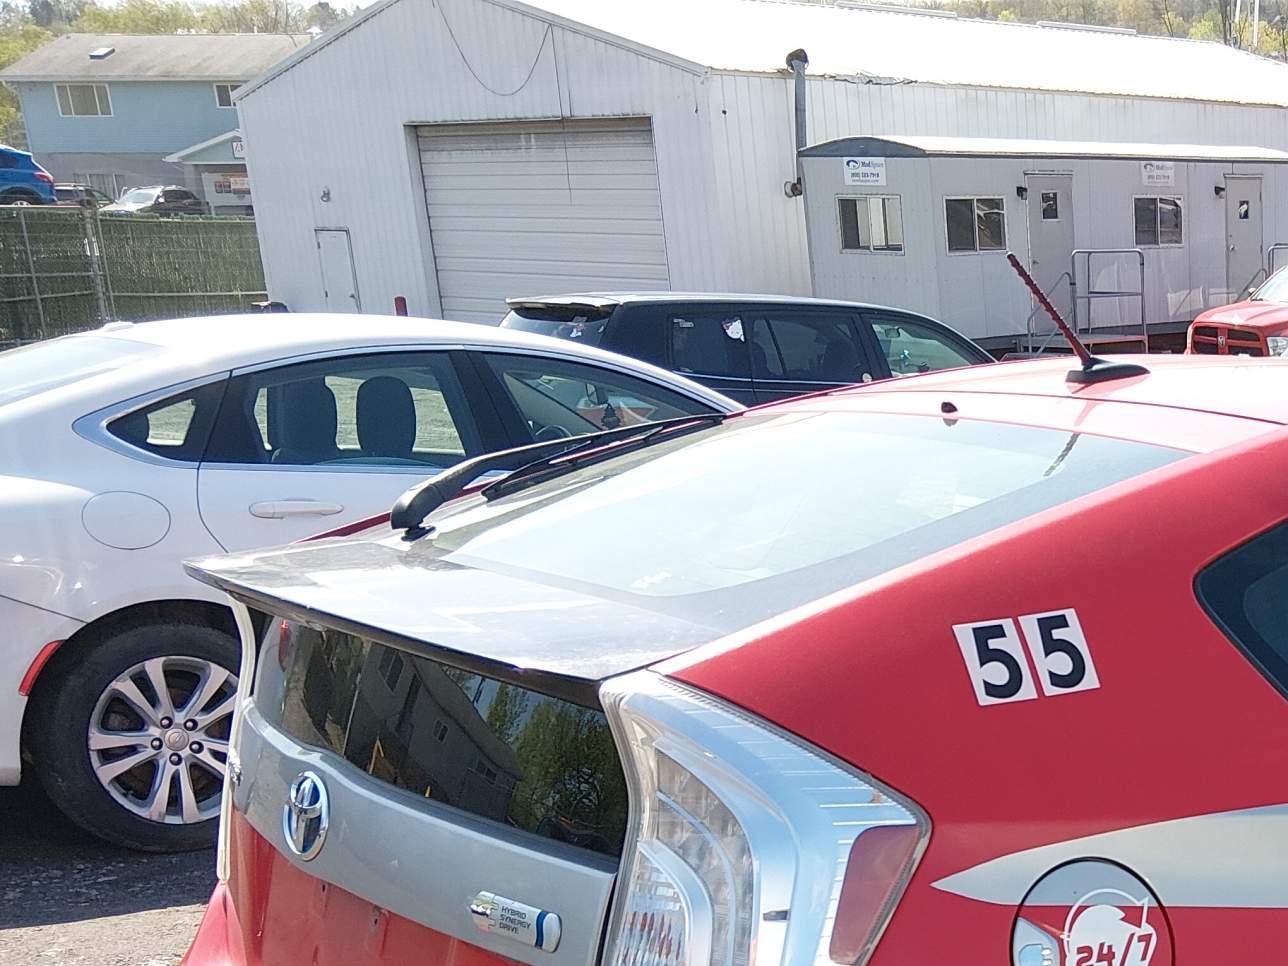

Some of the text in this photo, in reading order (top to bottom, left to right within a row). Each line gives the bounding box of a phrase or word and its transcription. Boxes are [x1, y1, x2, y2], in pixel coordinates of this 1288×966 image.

[972, 614, 1086, 699] 55
[501, 906, 526, 919] HYBRID
[499, 913, 531, 928] SYNERGY
[499, 922, 520, 934] DRIVE
